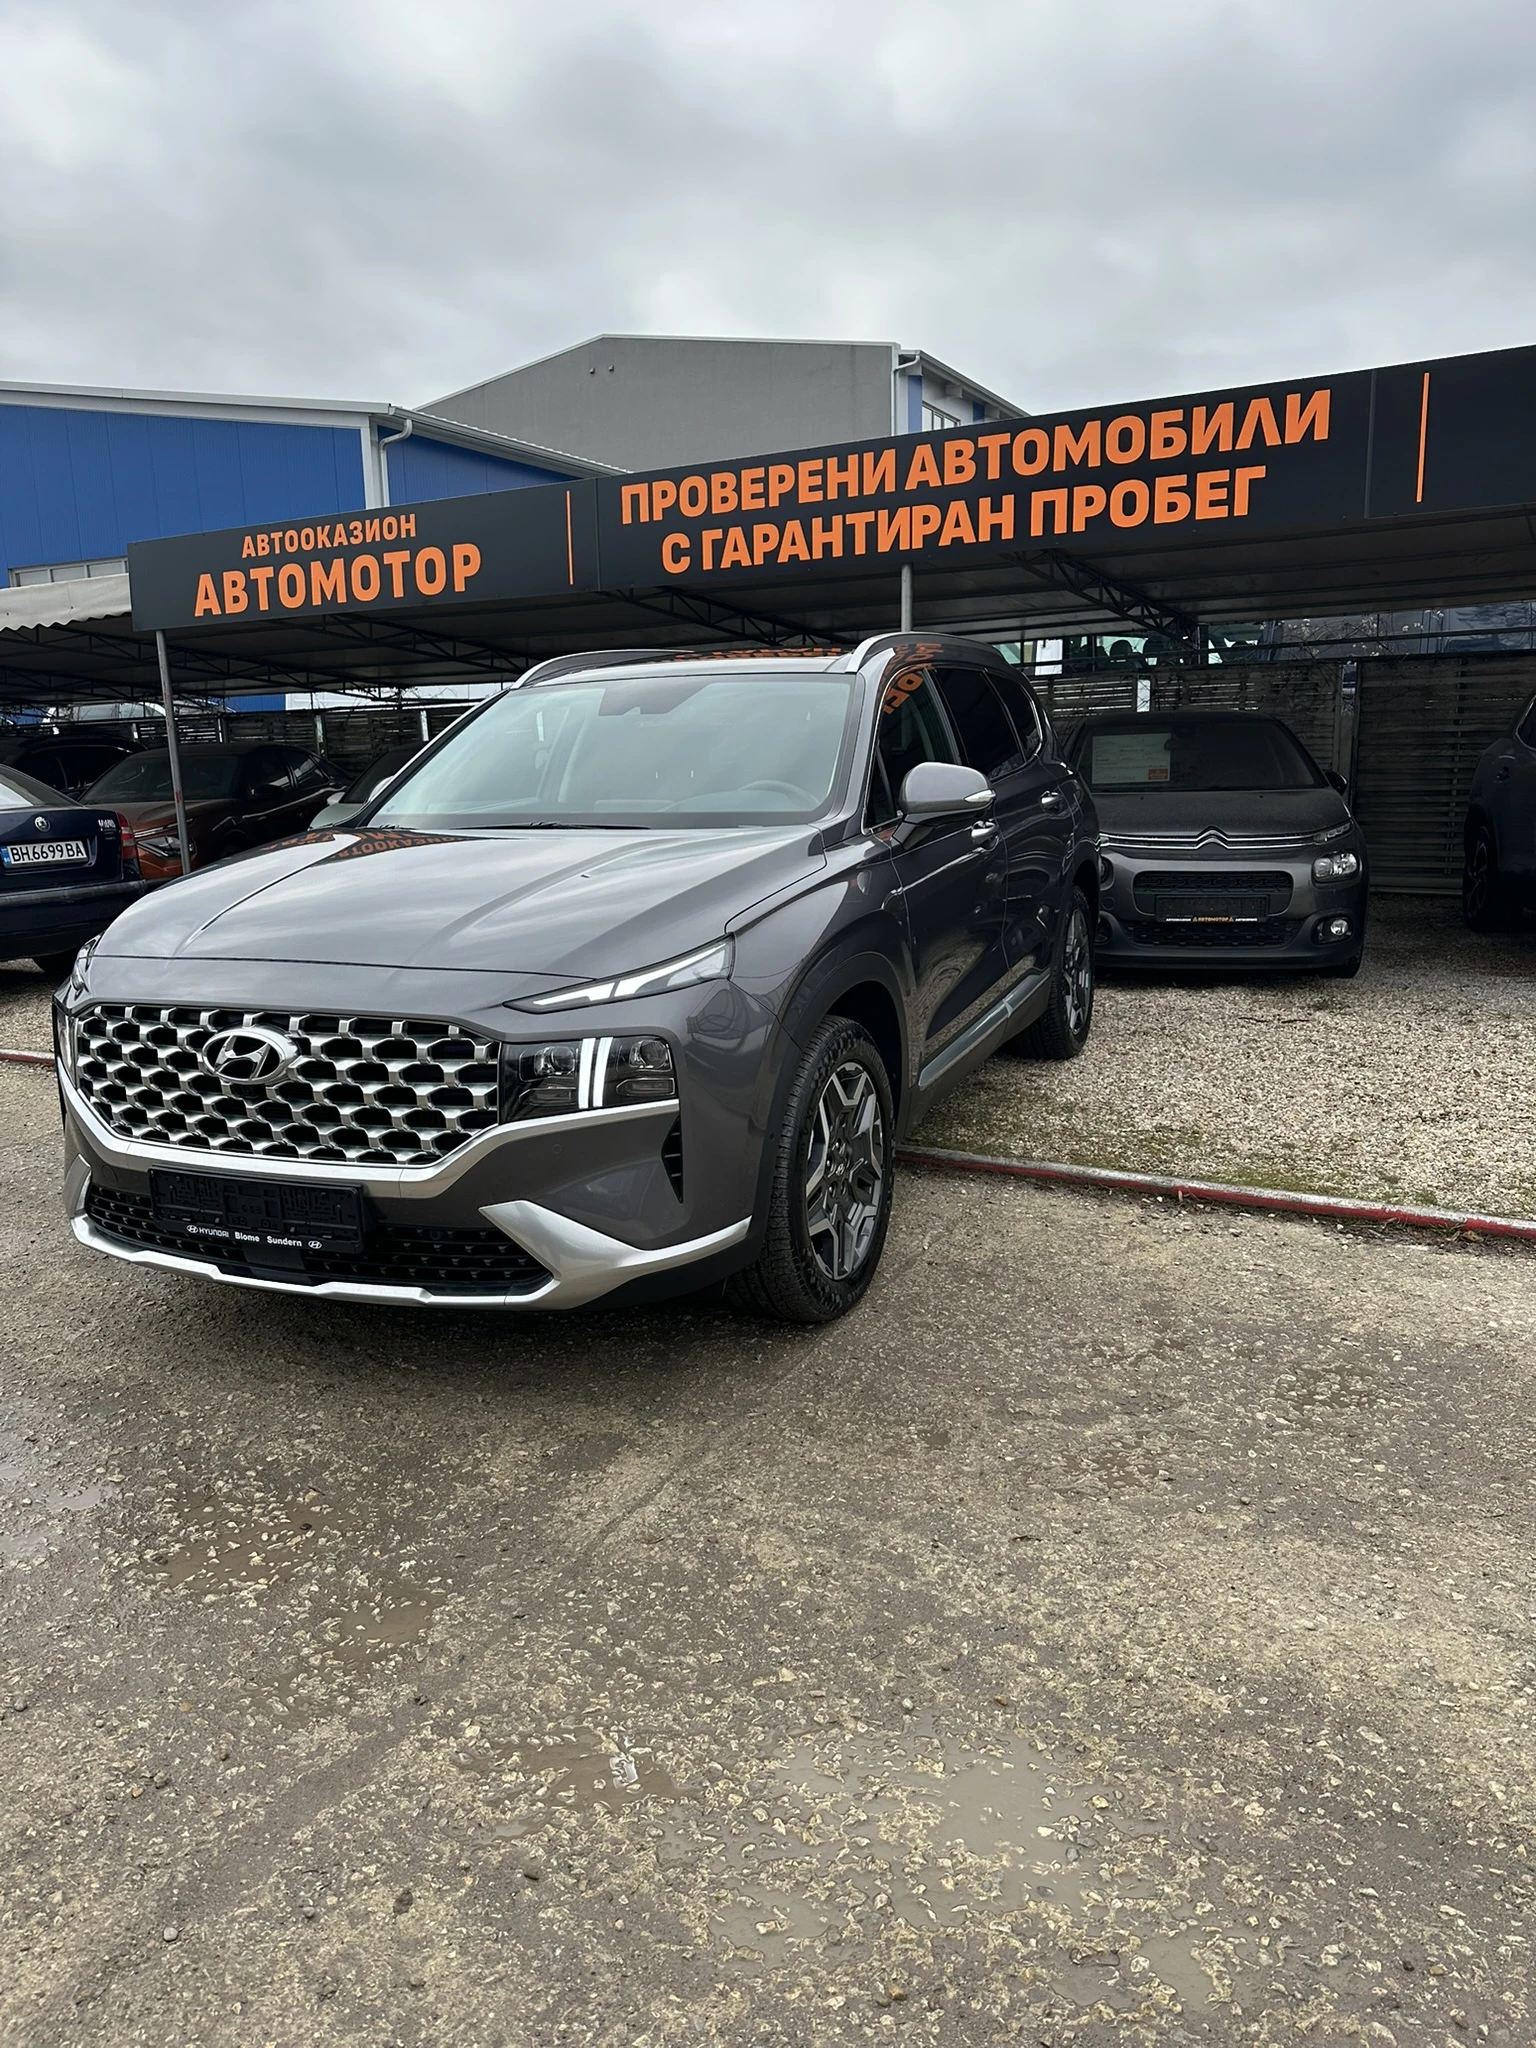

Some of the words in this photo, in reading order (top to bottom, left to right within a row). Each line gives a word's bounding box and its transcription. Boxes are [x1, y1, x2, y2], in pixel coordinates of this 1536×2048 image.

[621, 447, 897, 525] ПРОВЕРЕНИ
[904, 389, 1331, 491] АВТОМОБИЛИ
[242, 513, 417, 559] АВТООКАЗИОН
[662, 533, 691, 574] С
[701, 494, 1015, 570] ГАРАНТИРАН
[1030, 465, 1266, 537] ПРОБЕГ
[194, 543, 481, 617] АВТОМОТОР
[198, 1227, 230, 1238] HYUNDAI
[234, 1231, 260, 1242] Blome
[266, 1235, 302, 1247] Sundern
